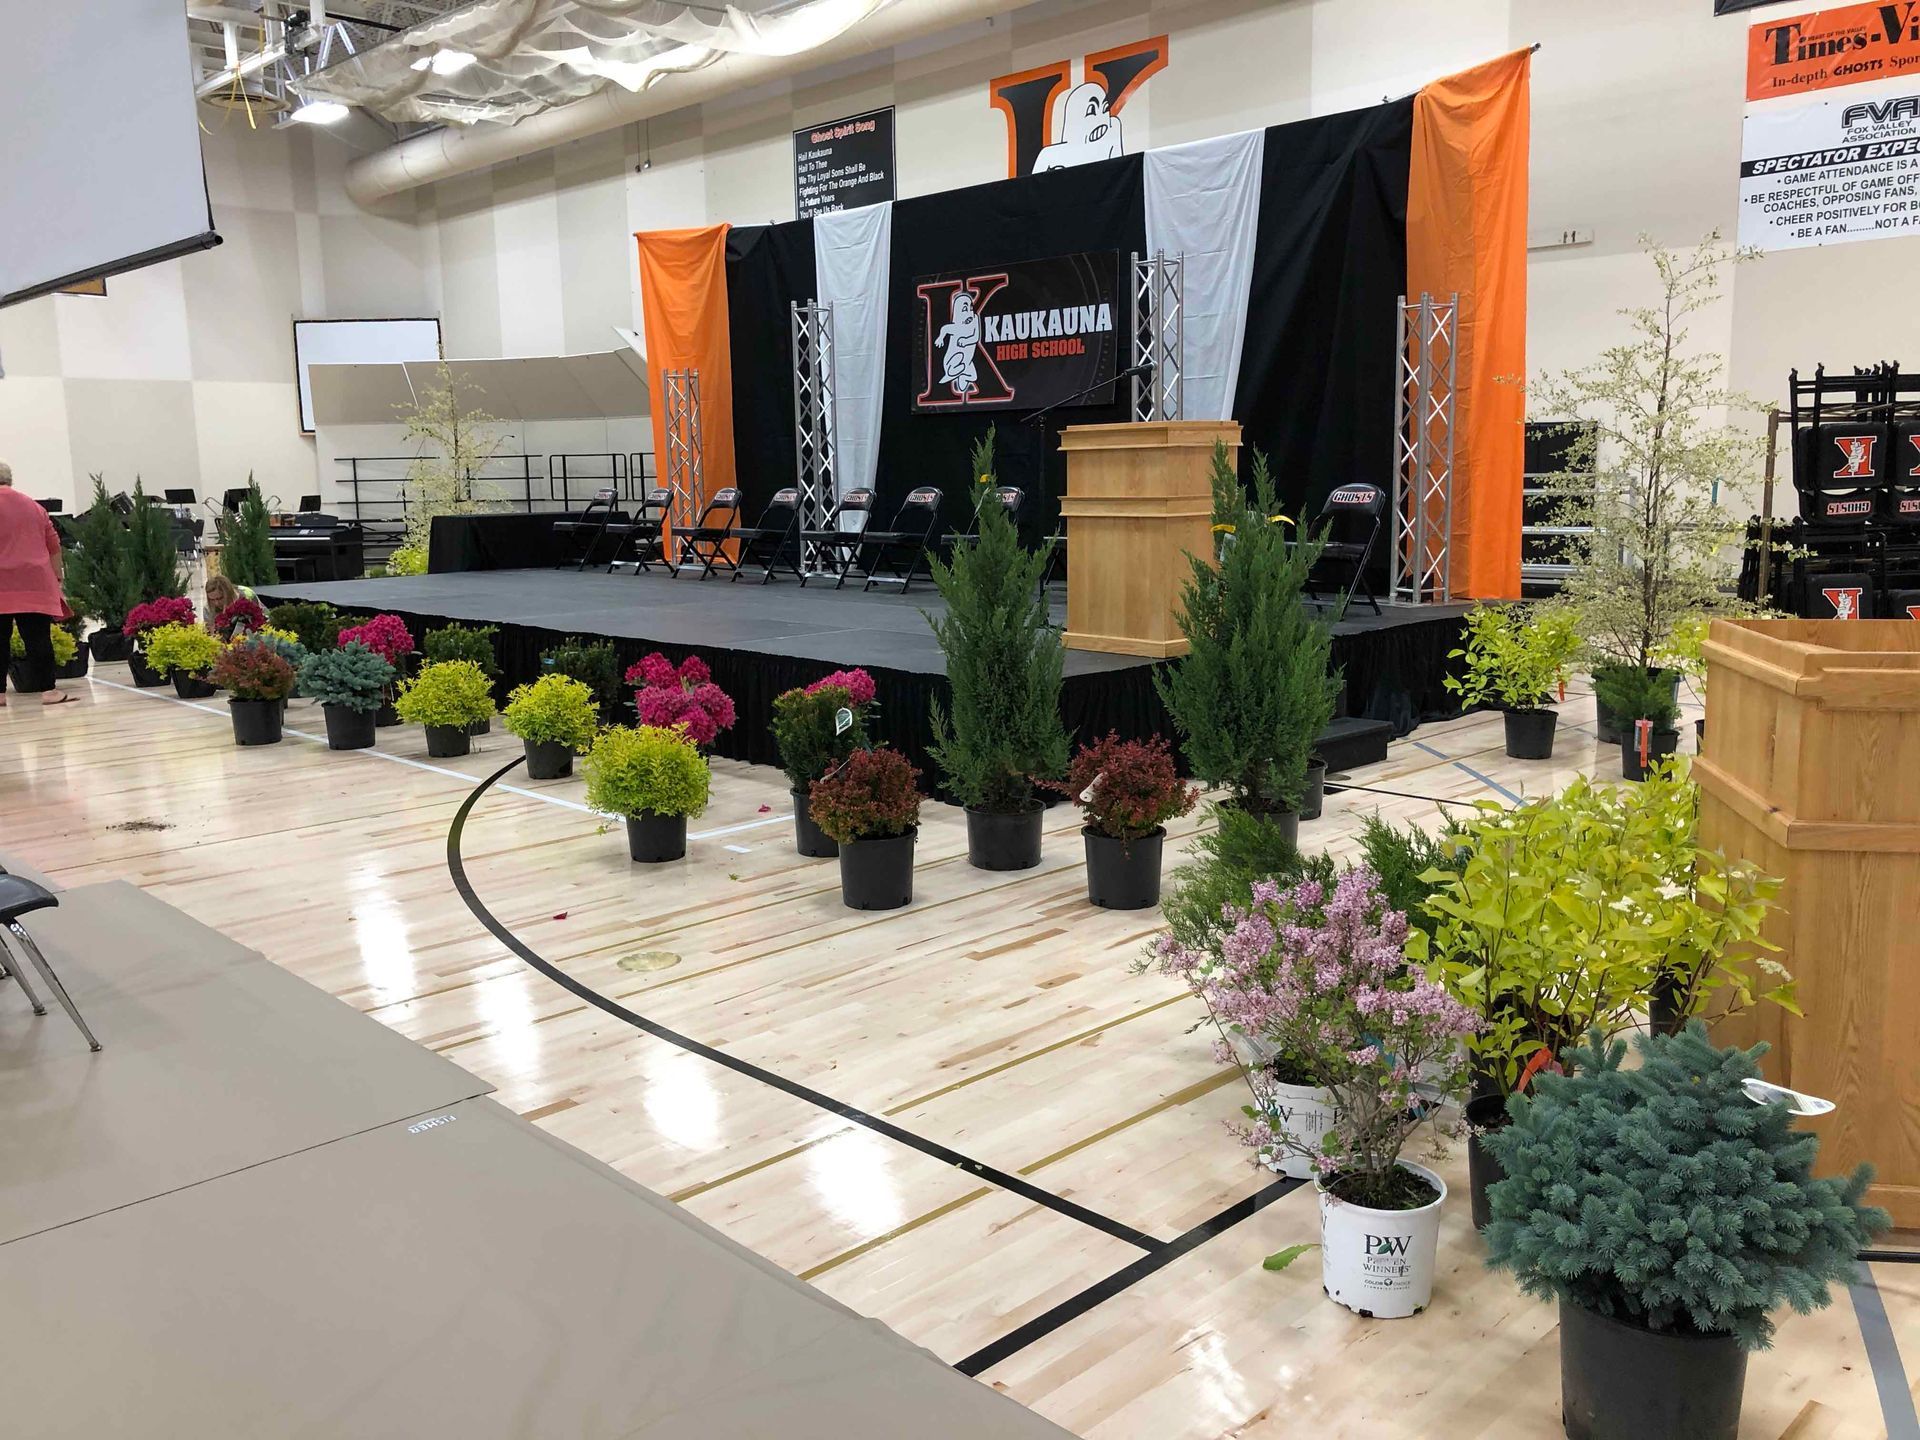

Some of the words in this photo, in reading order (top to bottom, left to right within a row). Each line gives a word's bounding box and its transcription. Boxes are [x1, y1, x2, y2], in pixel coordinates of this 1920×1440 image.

[1772, 69, 1828, 88] In-depth
[1833, 59, 1883, 76] GHOSTS
[1842, 95, 1920, 128] FVA
[811, 129, 834, 144] Ghost
[834, 124, 855, 139] Spirit
[855, 120, 876, 133] Song
[1842, 127, 1917, 144] ASSOCIATION
[1847, 126, 1869, 136] FOX
[1872, 120, 1913, 132] VALLEY
[798, 152, 808, 162] Hail
[808, 147, 833, 160] Kaukauna
[1752, 147, 1861, 175] SPECTATOR
[798, 164, 808, 174] Hail
[808, 163, 815, 171] To
[816, 161, 828, 170] Thee
[799, 176, 807, 185] We
[807, 174, 816, 184] Thy
[817, 170, 831, 181] Loyal
[831, 168, 844, 177] Sons
[845, 164, 858, 175] Shall
[859, 162, 866, 171] Be
[1784, 172, 1815, 185] GAME
[1818, 161, 1893, 180] ATTENDANCE
[1896, 159, 1907, 170] IS
[1910, 158, 1919, 168] A
[800, 186, 819, 197] Fighting
[819, 183, 828, 192] For
[829, 181, 838, 190] The
[839, 177, 857, 188] Orange
[858, 175, 868, 185] And
[869, 170, 884, 182] Black
[1750, 193, 1765, 204] BE
[1768, 182, 1838, 202] RESPECTFUL
[1842, 180, 1857, 192] OF
[1860, 176, 1894, 190] GAME
[805, 197, 820, 206] Future
[821, 195, 835, 203] Years
[1763, 198, 1819, 213] COACHES,
[1822, 190, 1881, 206] OPPOSING
[1884, 185, 1918, 200] FANS,
[1776, 213, 1813, 226] CHEER
[1816, 205, 1880, 222] POSITIVELY
[1883, 201, 1907, 213] FOR
[1797, 227, 1812, 238] BE
[1814, 226, 1823, 236] A
[1901, 216, 1910, 226] A
[984, 303, 1113, 343] KAUKAUNA
[996, 343, 1028, 361] HIGH
[1032, 338, 1086, 359] SCHOOL
[1332, 490, 1376, 504] GHOSTS
[408, 1115, 457, 1134] FISHER
[1364, 1233, 1413, 1257] PW
